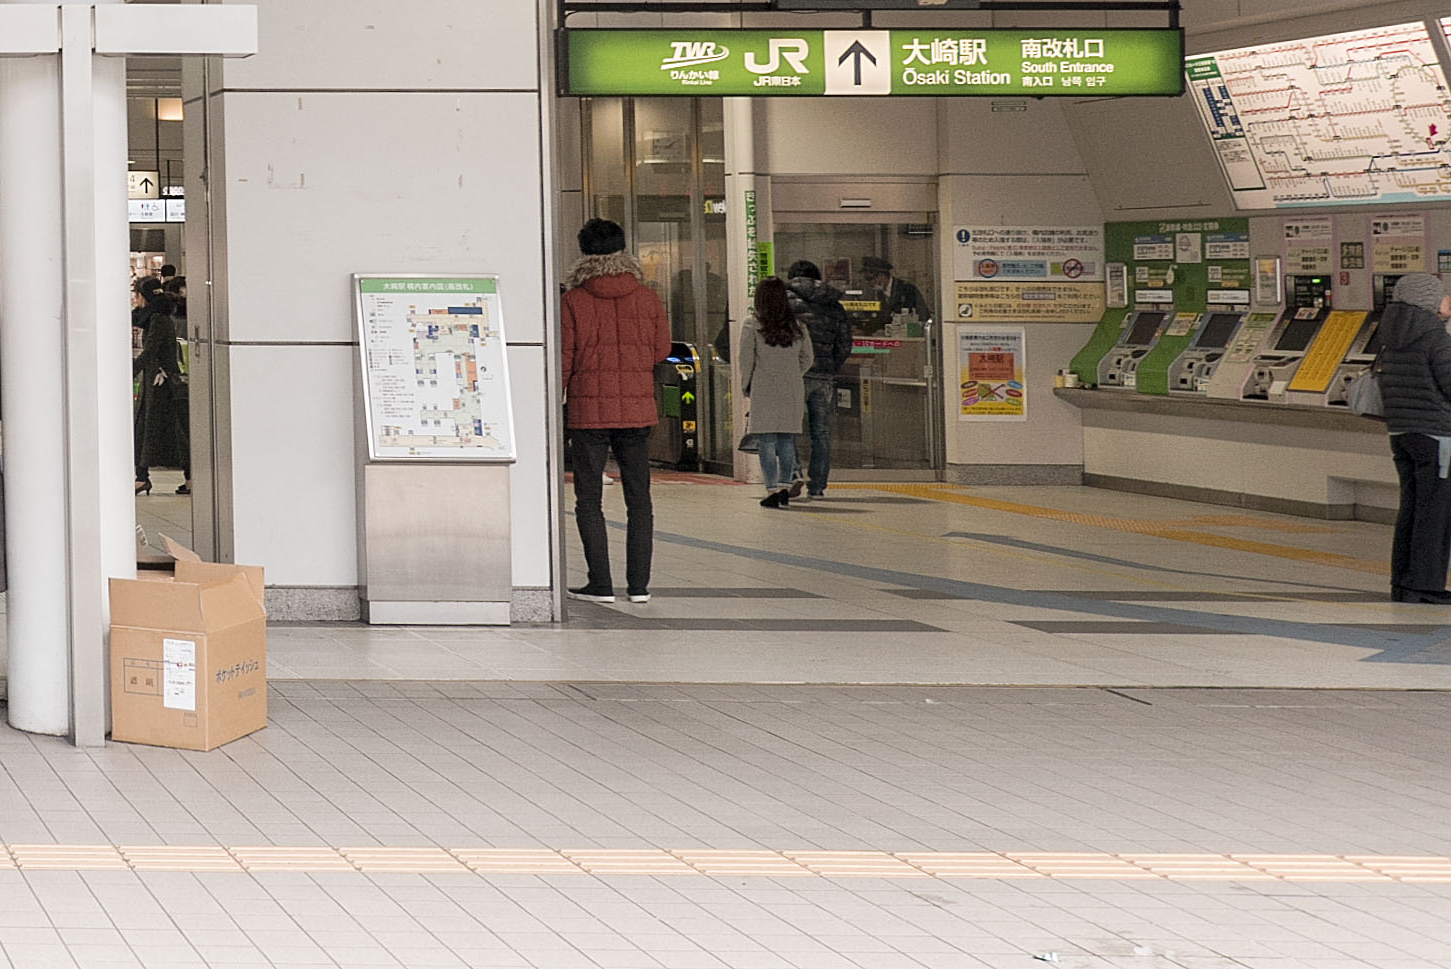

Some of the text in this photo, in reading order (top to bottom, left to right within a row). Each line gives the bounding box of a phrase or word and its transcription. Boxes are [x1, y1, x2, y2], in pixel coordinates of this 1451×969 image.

[902, 38, 988, 66] 大崎駅
[1020, 38, 1104, 59] 南改札口
[744, 38, 810, 74] JR
[1021, 61, 1114, 73] South Entrance
[670, 70, 719, 80] りんかい線
[902, 68, 1011, 86] Ōsaki Station
[753, 76, 802, 87] JR東日本
[1021, 76, 1053, 87] 南入口
[1061, 76, 1107, 87] 남쪽 입구
